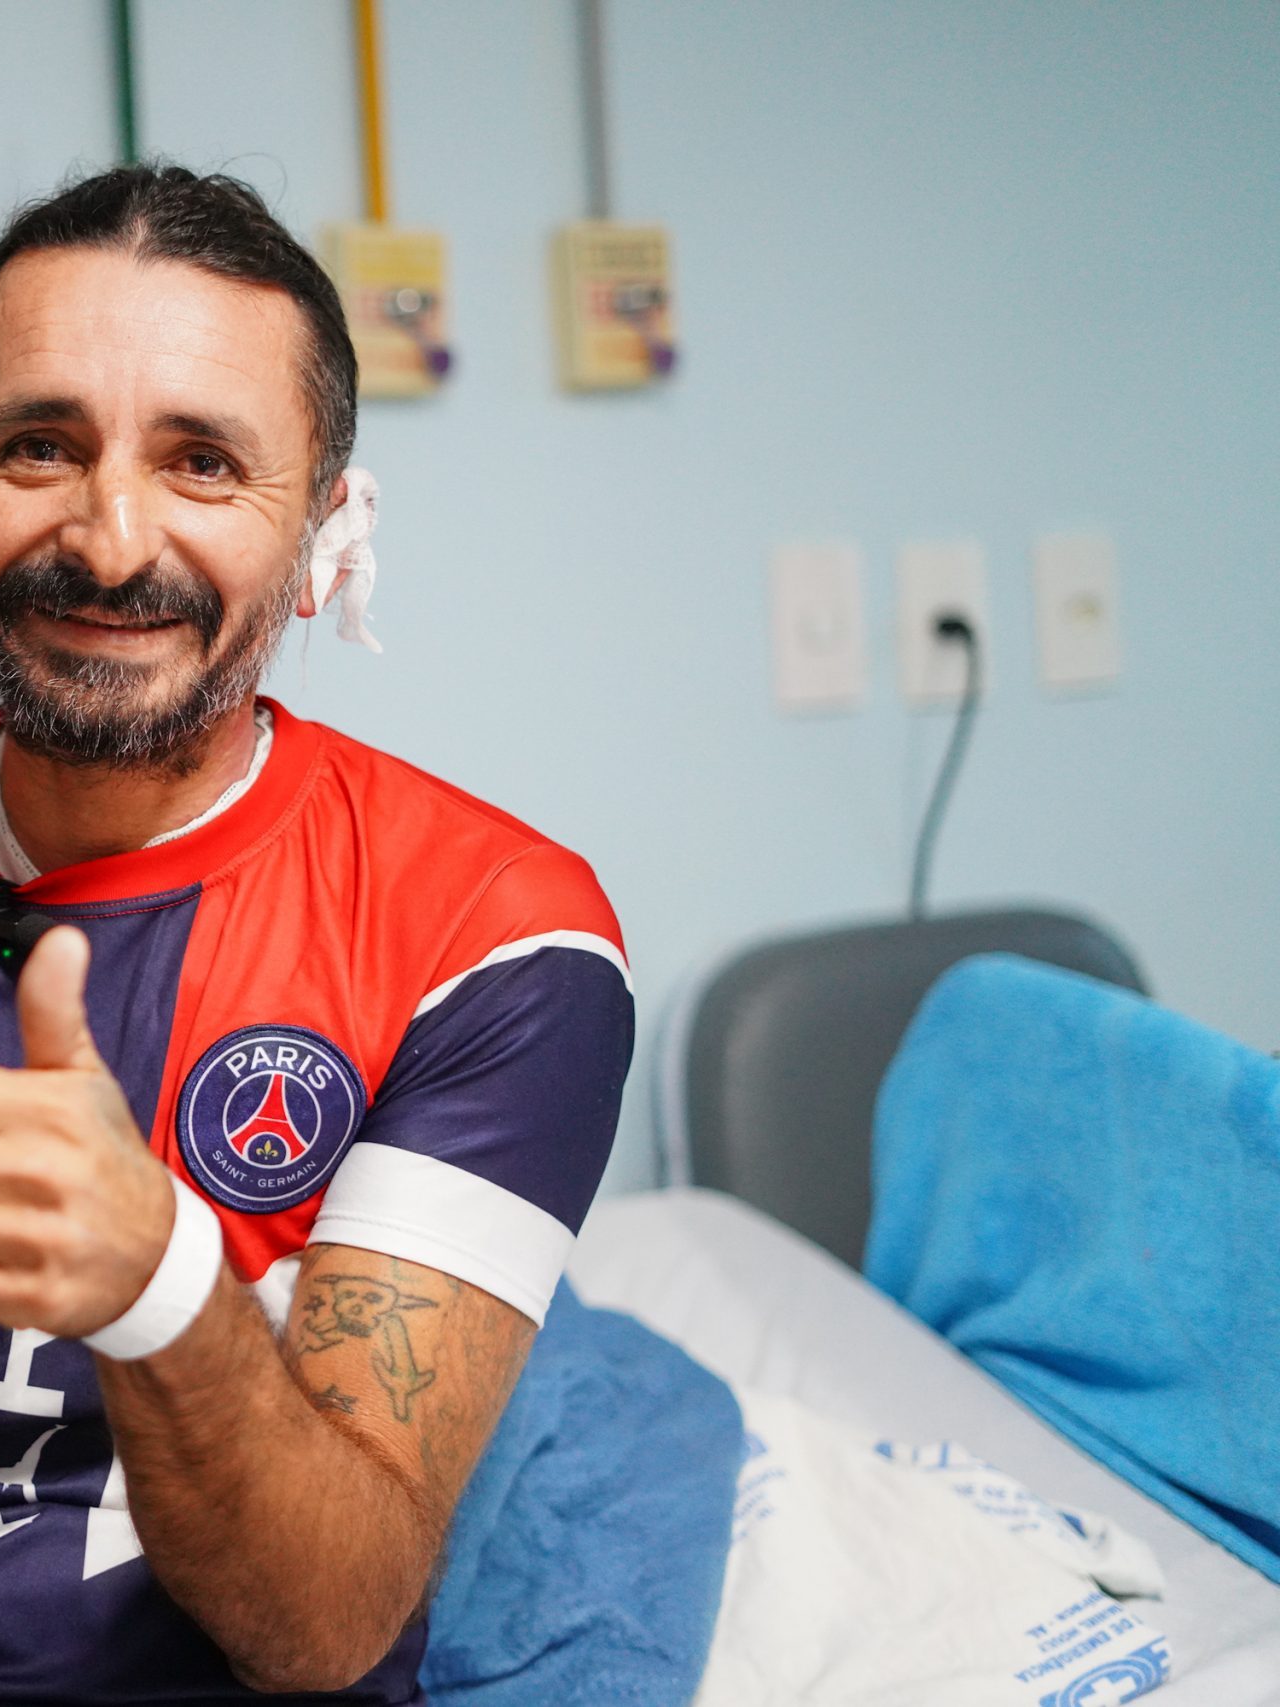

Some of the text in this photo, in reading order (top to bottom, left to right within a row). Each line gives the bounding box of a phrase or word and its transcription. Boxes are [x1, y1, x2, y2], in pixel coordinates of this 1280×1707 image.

[225, 1045, 333, 1090] PARIS
[212, 1150, 247, 1182] SAINT
[257, 1160, 317, 1188] GERMAIN
